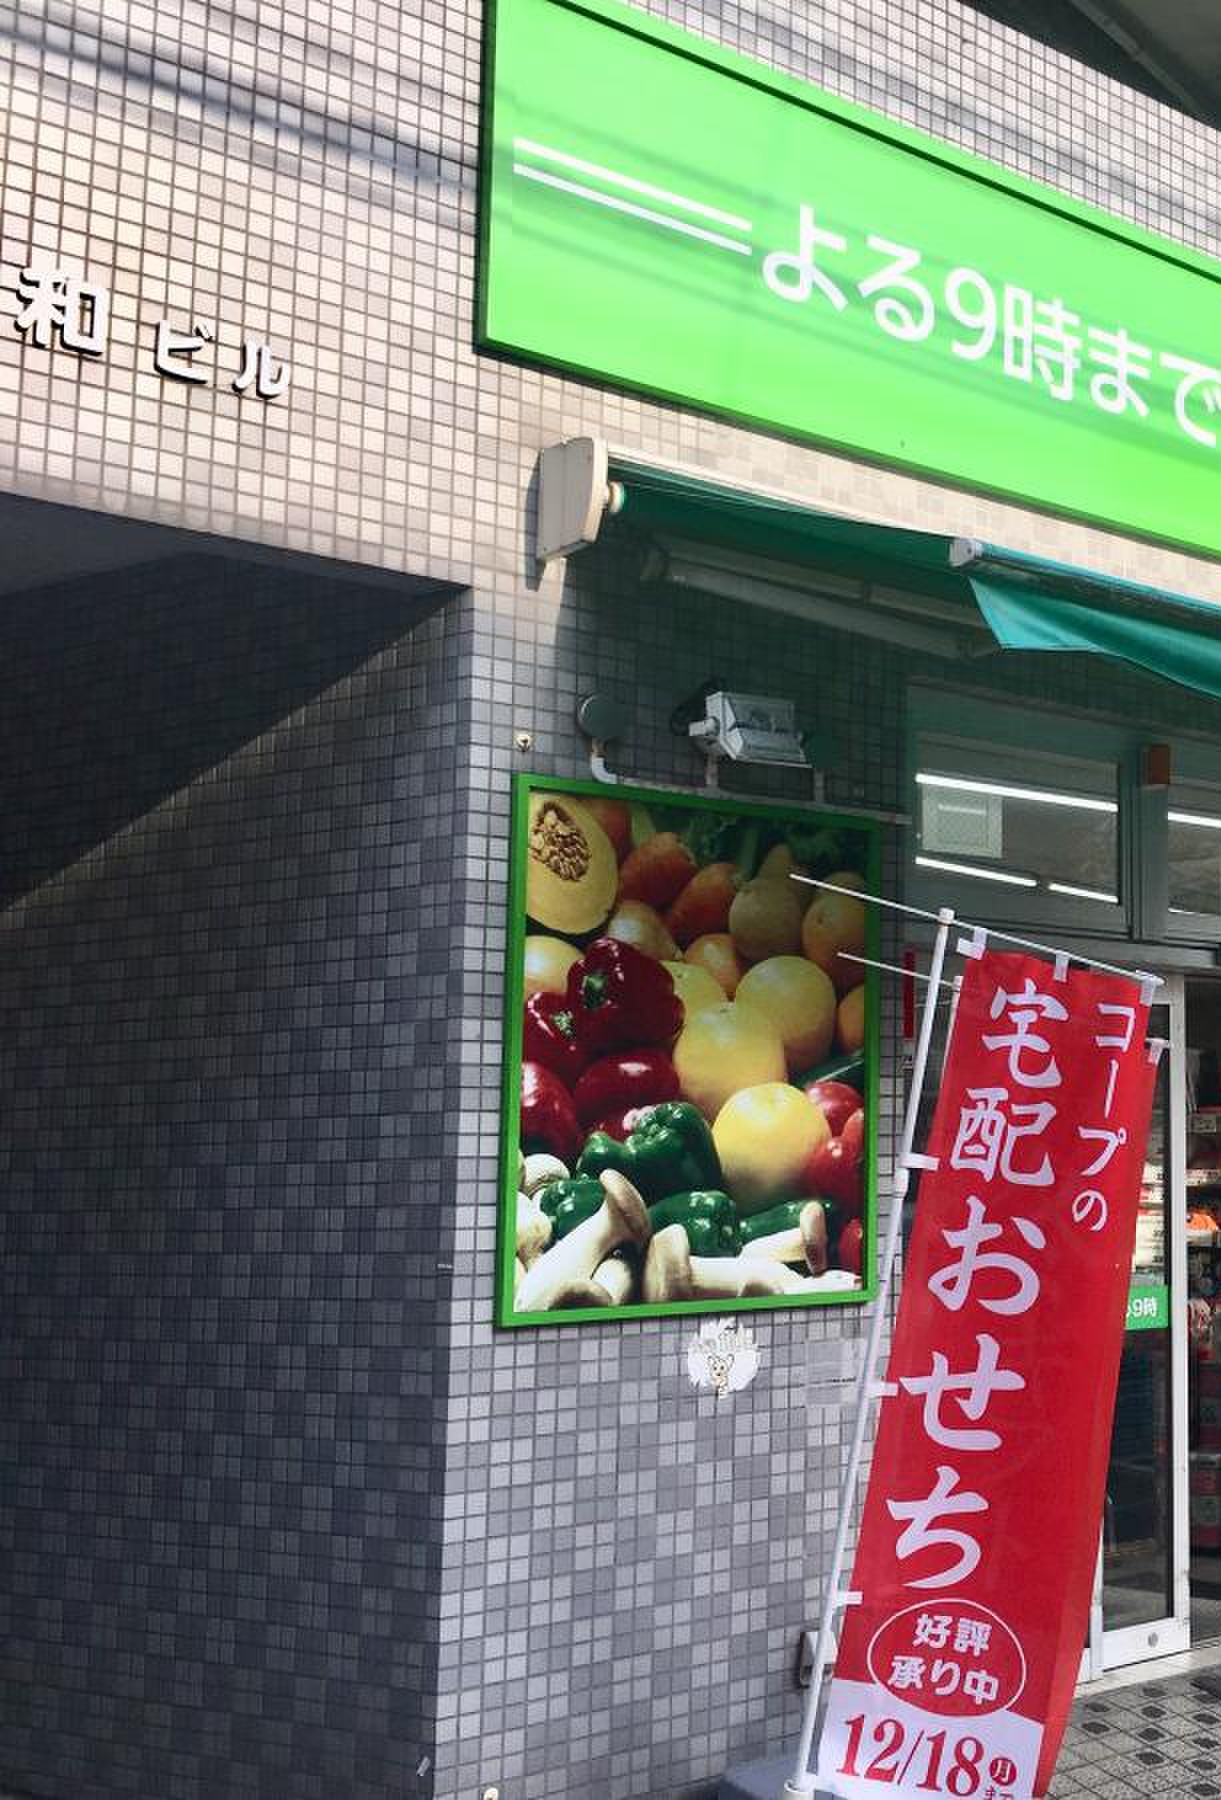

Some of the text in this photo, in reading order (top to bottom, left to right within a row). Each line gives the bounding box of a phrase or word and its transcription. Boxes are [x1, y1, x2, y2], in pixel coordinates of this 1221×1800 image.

[1072, 1002, 1136, 1232] コープの
[886, 978, 1070, 1589] 宅配おせち
[912, 1613, 992, 1656] 好評
[887, 1655, 999, 1705] 承り中
[836, 1713, 985, 1797] 12/18
